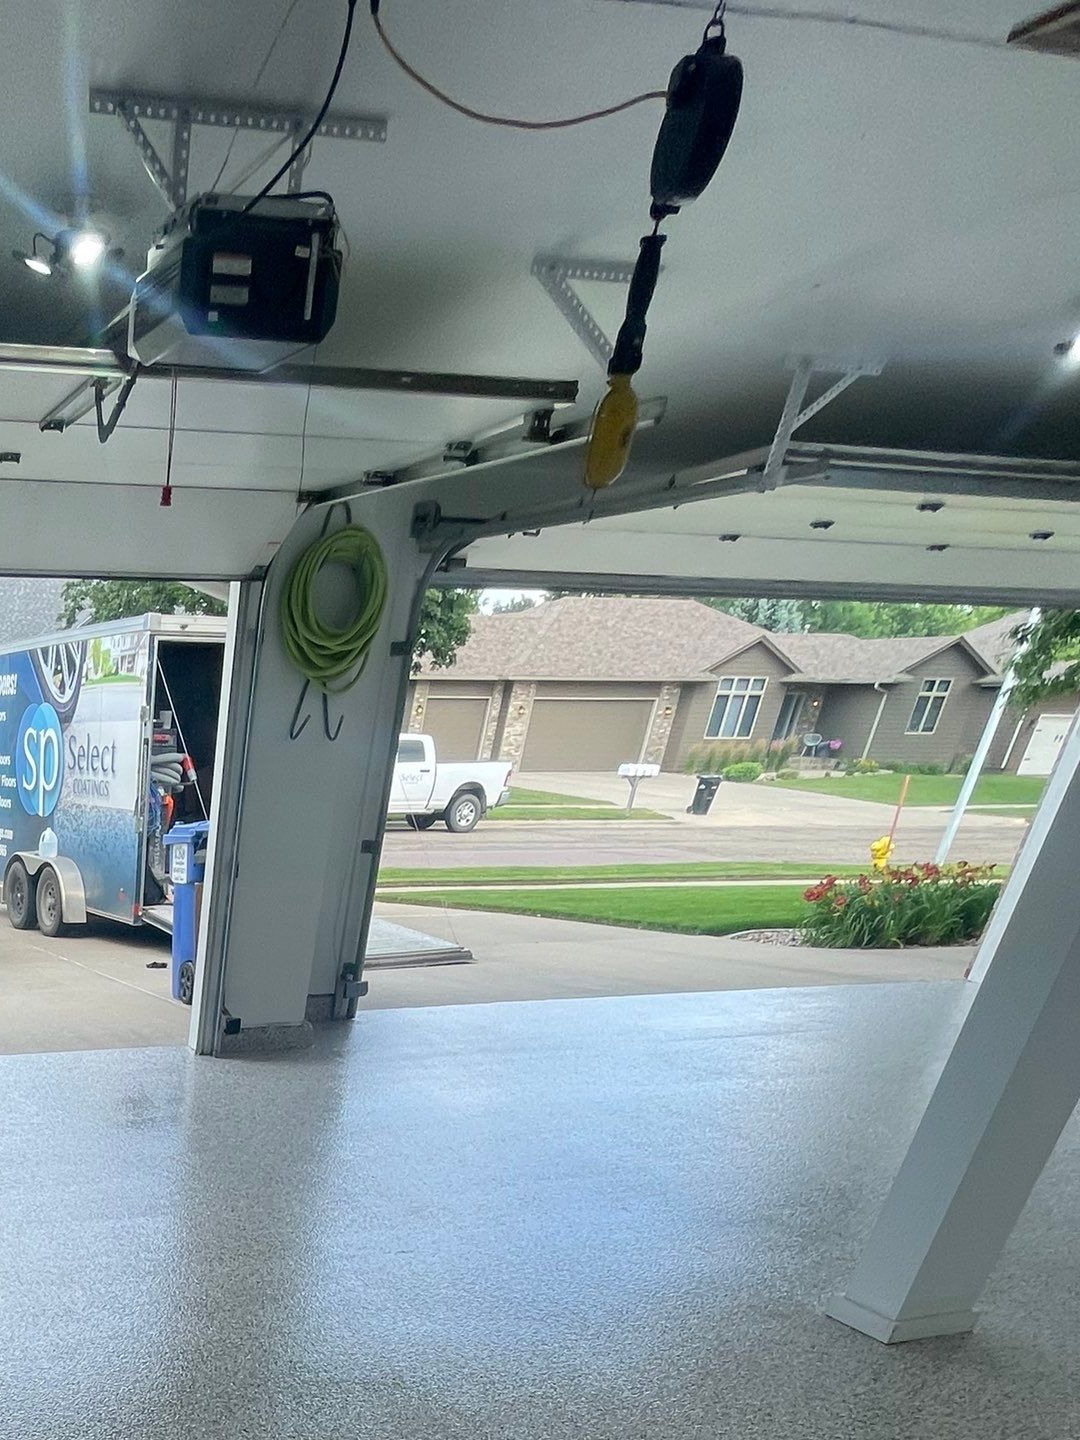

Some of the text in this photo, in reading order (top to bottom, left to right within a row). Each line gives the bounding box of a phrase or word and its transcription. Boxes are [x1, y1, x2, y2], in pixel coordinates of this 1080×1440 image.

[67, 732, 117, 774] Select
[1, 774, 17, 788] Floors
[72, 778, 110, 797] COATINGS
